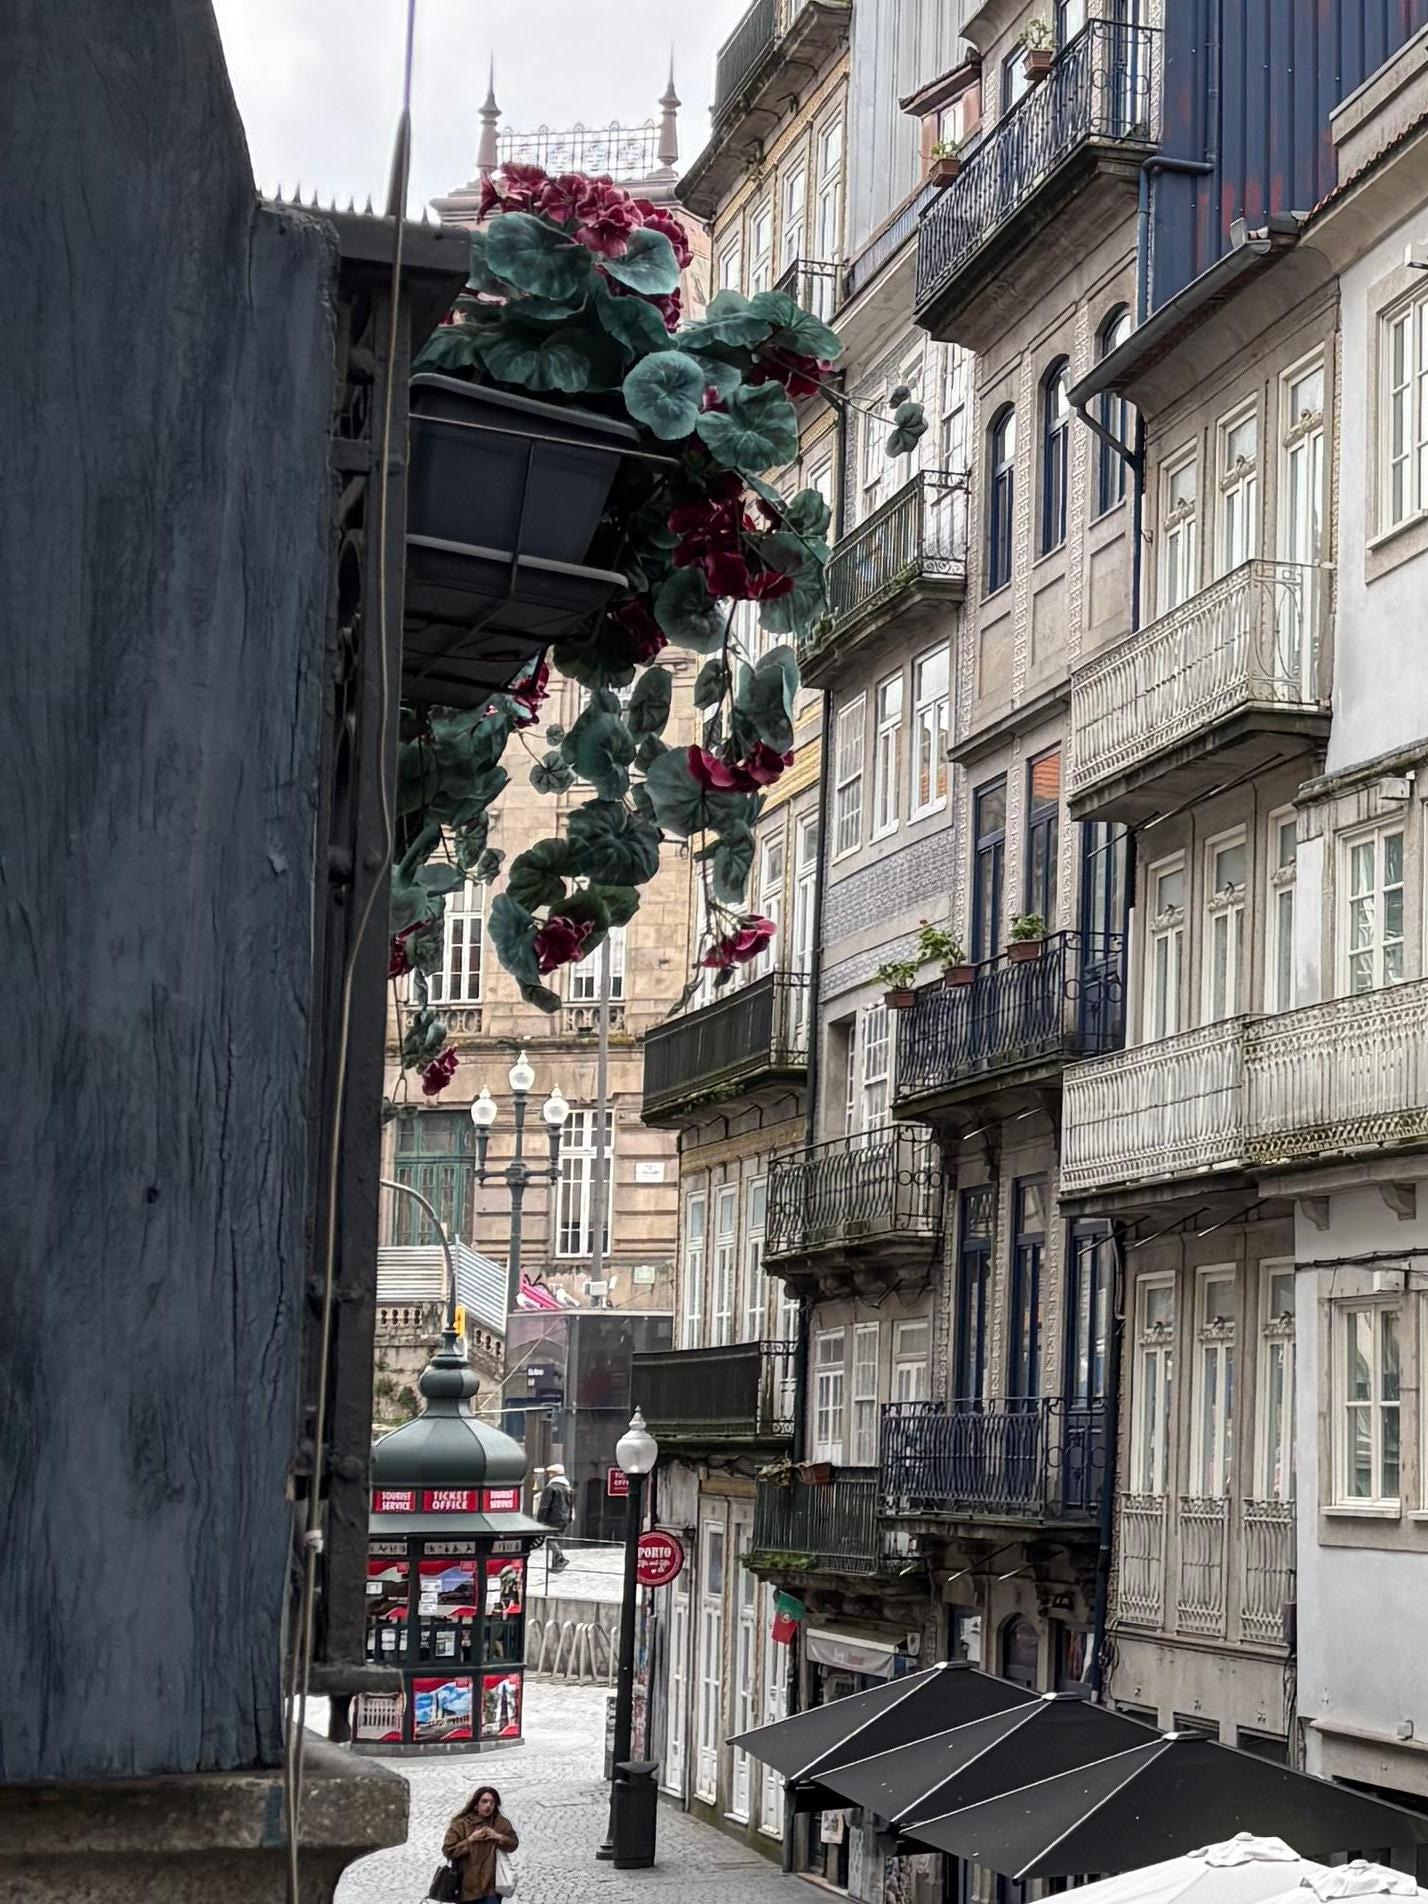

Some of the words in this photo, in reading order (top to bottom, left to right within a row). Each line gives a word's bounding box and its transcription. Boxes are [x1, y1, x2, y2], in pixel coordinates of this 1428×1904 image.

[433, 1491, 468, 1500] TICKET
[432, 1500, 468, 1510] OFFICE
[638, 1547, 672, 1558] PORTO
